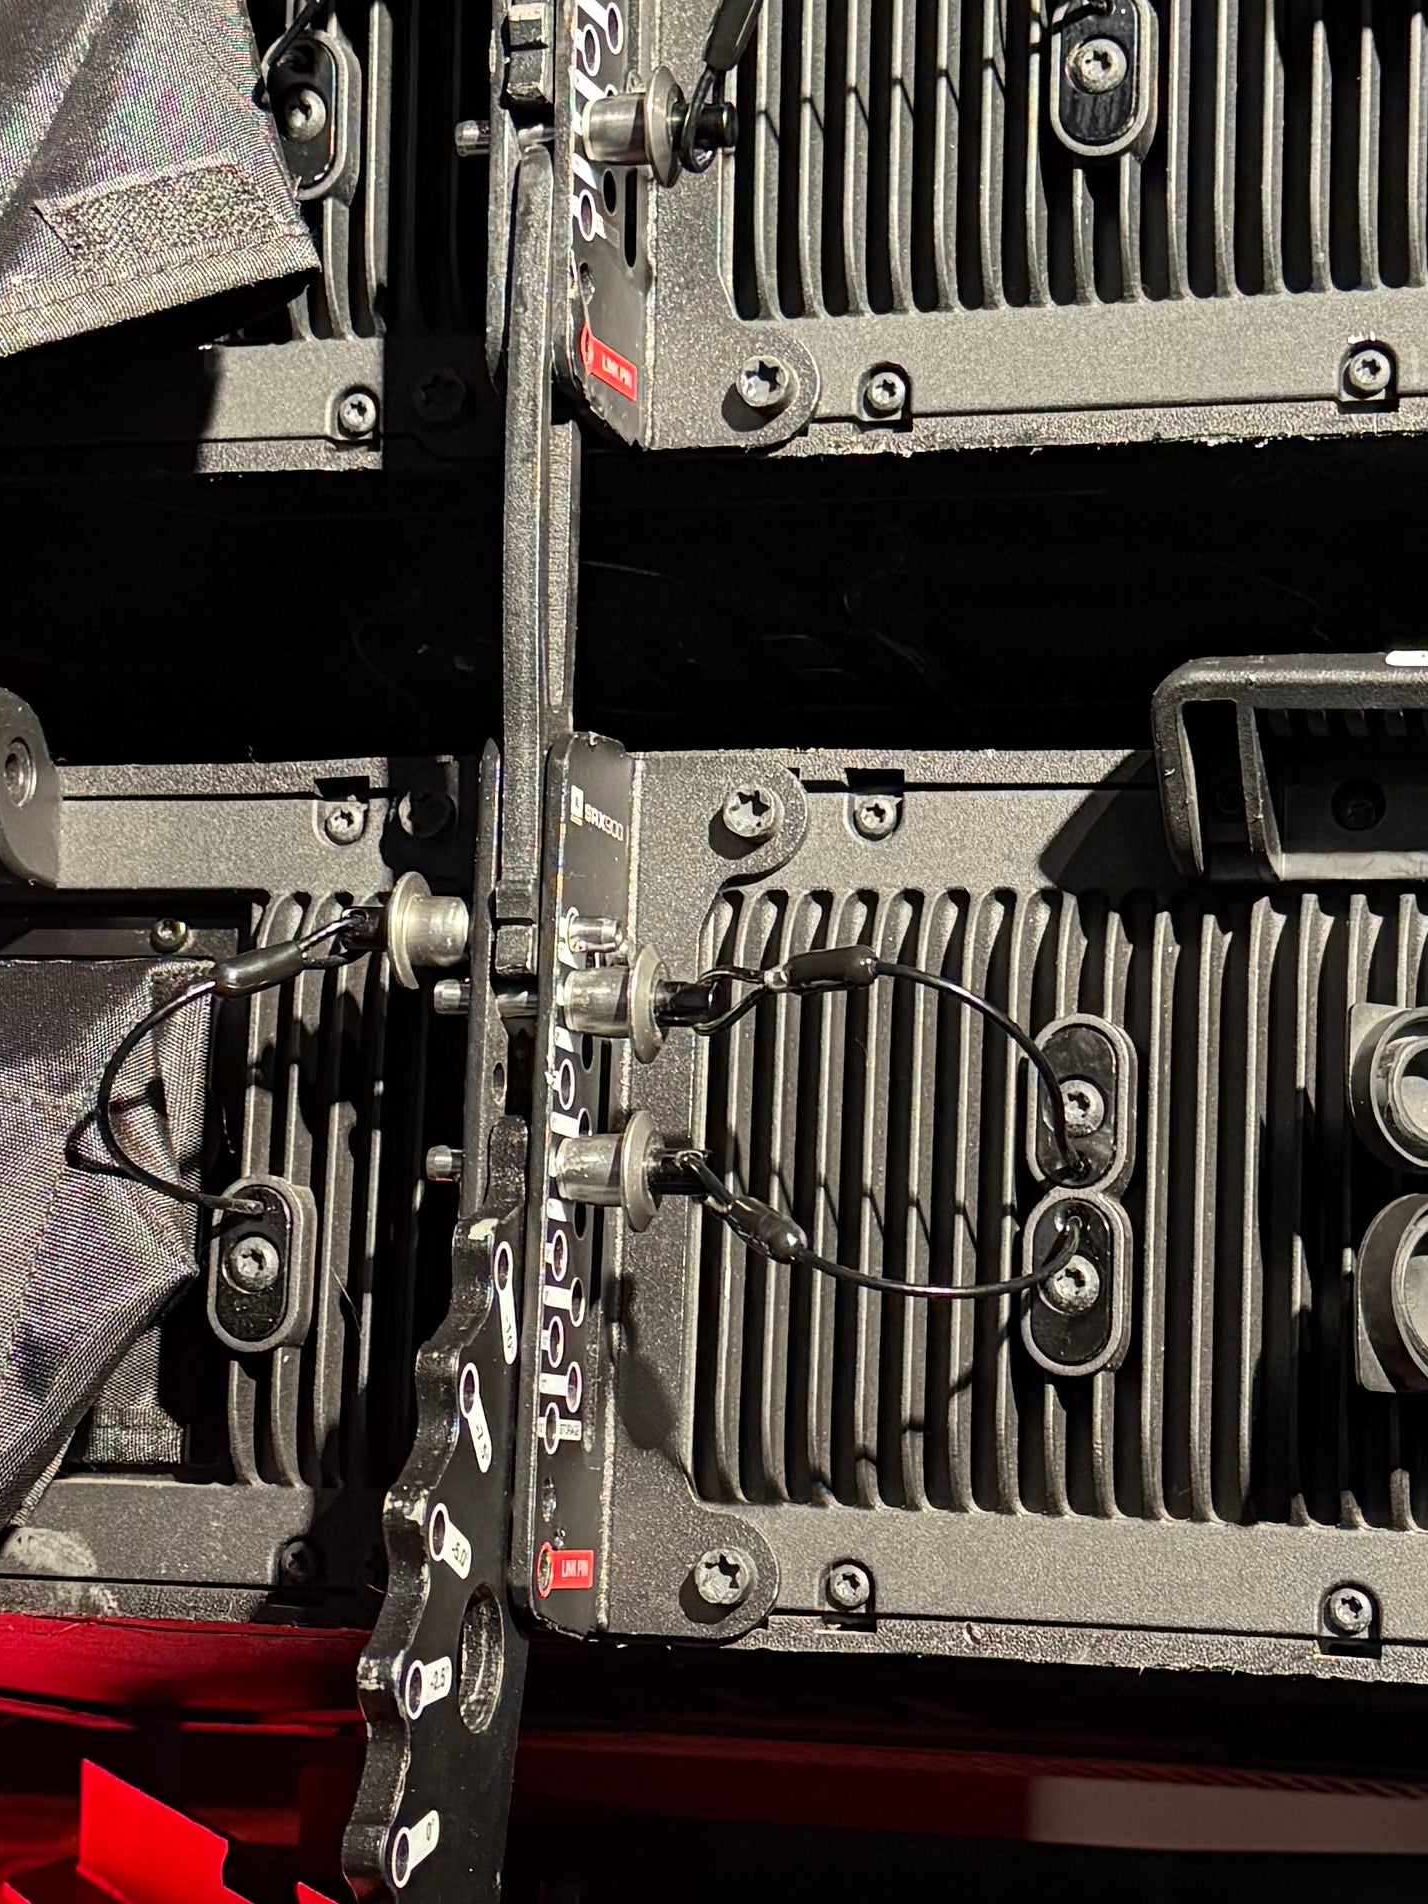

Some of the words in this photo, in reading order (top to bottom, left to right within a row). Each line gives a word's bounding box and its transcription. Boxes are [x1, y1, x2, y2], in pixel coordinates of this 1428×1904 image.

[561, 1559, 577, 1578] LINK
[577, 1559, 589, 1578] PIN
[430, 1666, 449, 1690] -2.5°
